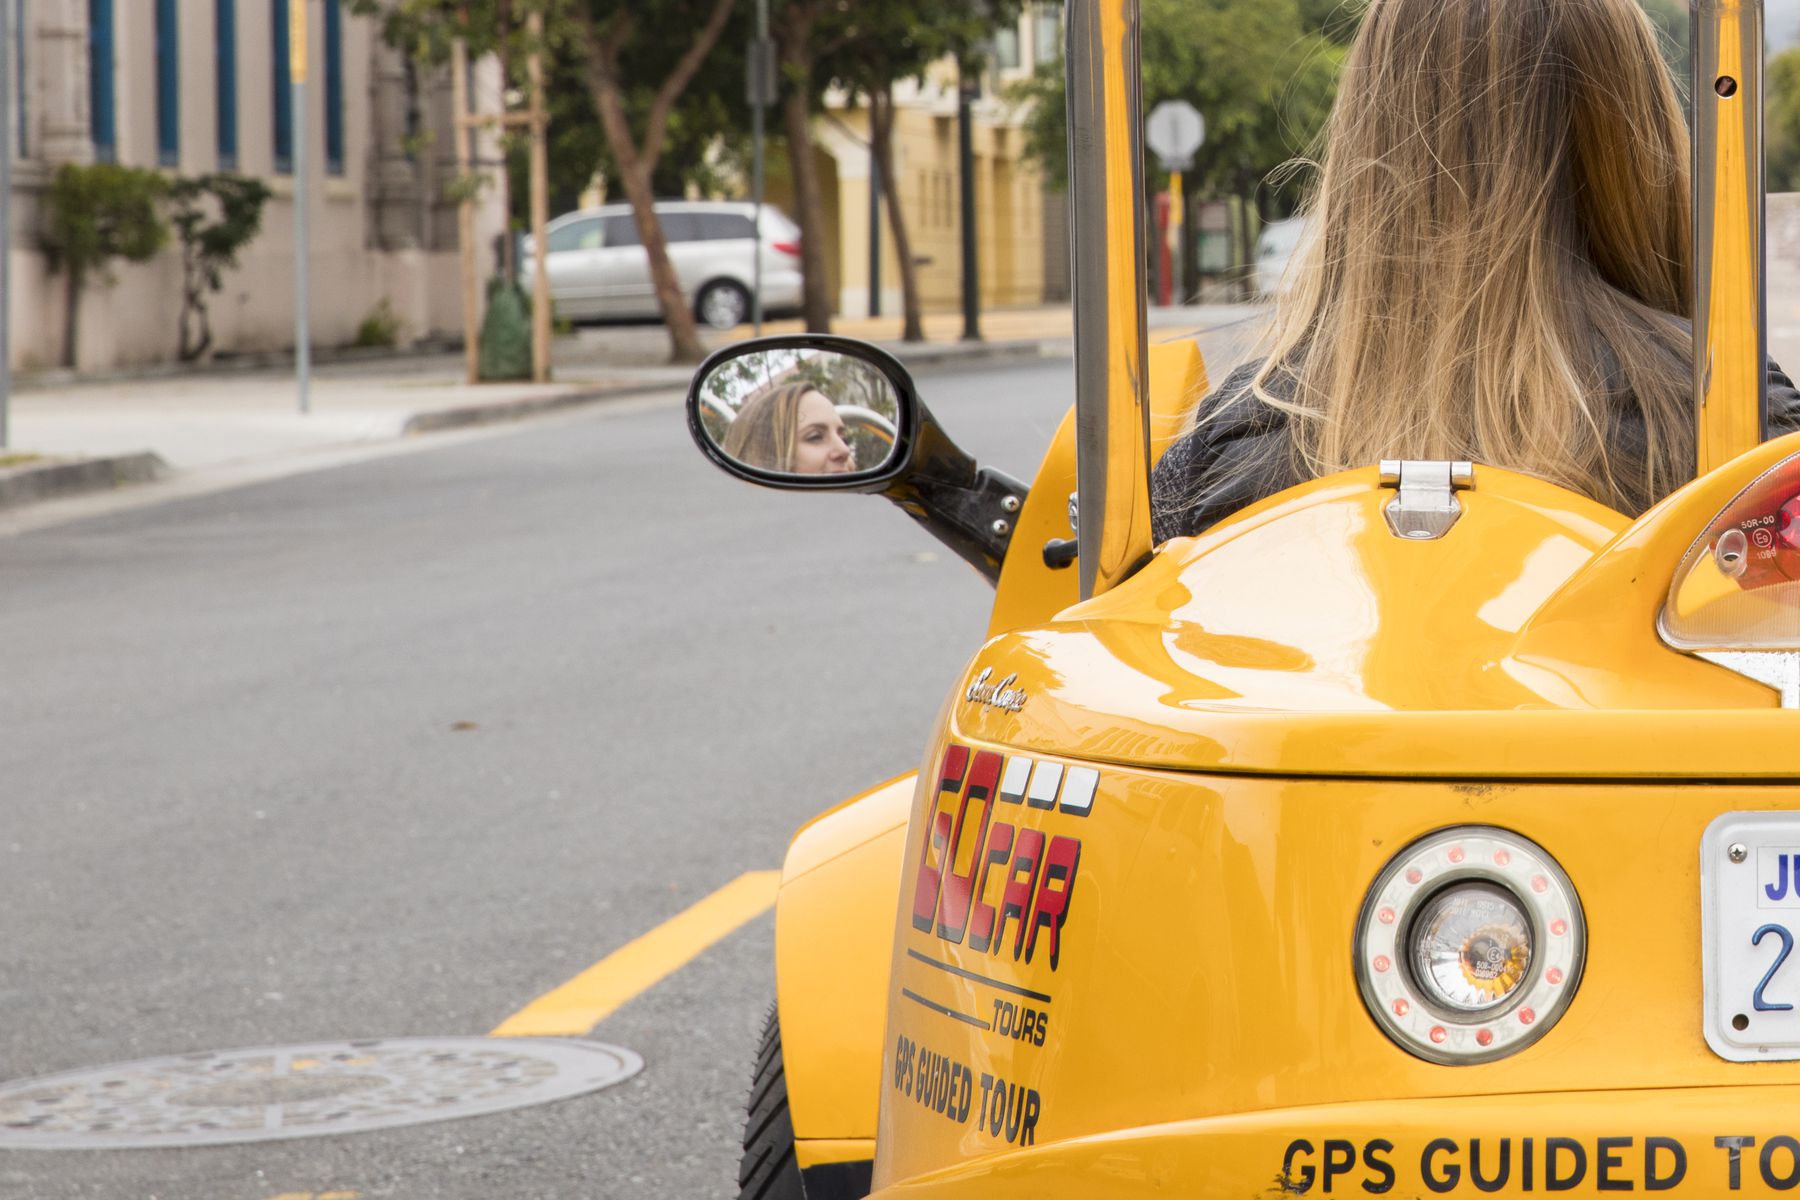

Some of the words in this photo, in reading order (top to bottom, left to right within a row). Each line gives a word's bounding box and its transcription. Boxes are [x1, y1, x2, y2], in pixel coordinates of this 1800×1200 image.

[1741, 515, 1775, 529] 50R-00
[992, 998, 1049, 1047] TOURS
[894, 1033, 917, 1098] GPS
[915, 1046, 972, 1124] GUIDED
[978, 1072, 1041, 1147] TOUR
[1281, 1138, 1396, 1195] GPS
[1420, 1135, 1688, 1193] GUIDED
